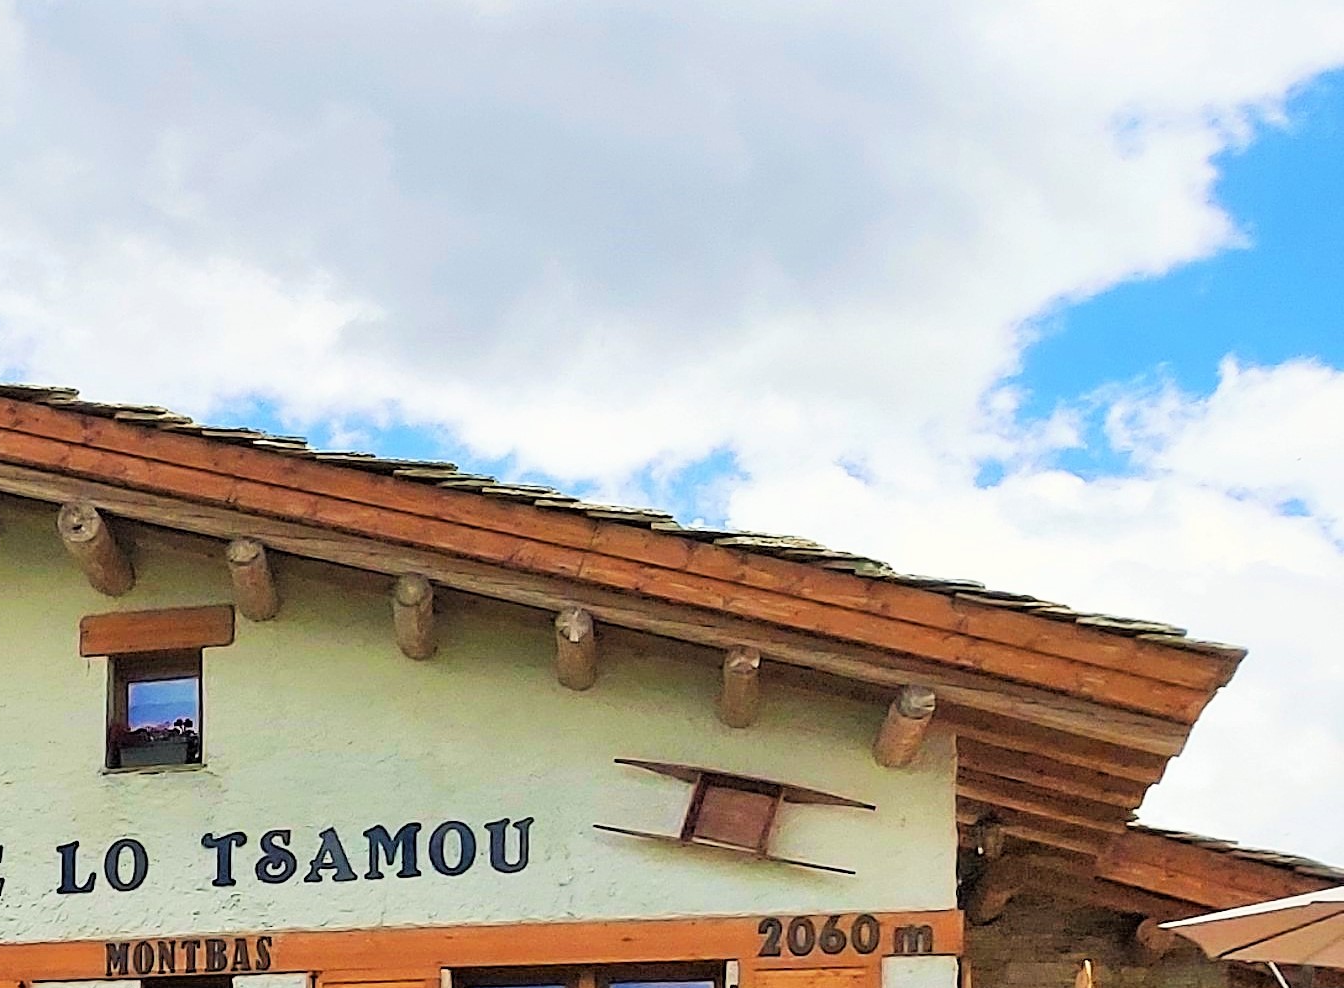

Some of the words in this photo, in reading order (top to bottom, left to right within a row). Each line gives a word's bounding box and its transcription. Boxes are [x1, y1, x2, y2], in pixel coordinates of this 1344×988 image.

[56, 838, 150, 893] LO
[200, 816, 535, 888] TSAMOU
[105, 936, 273, 976] MONTBAS
[758, 913, 880, 957] 2060
[893, 924, 934, 954] m
